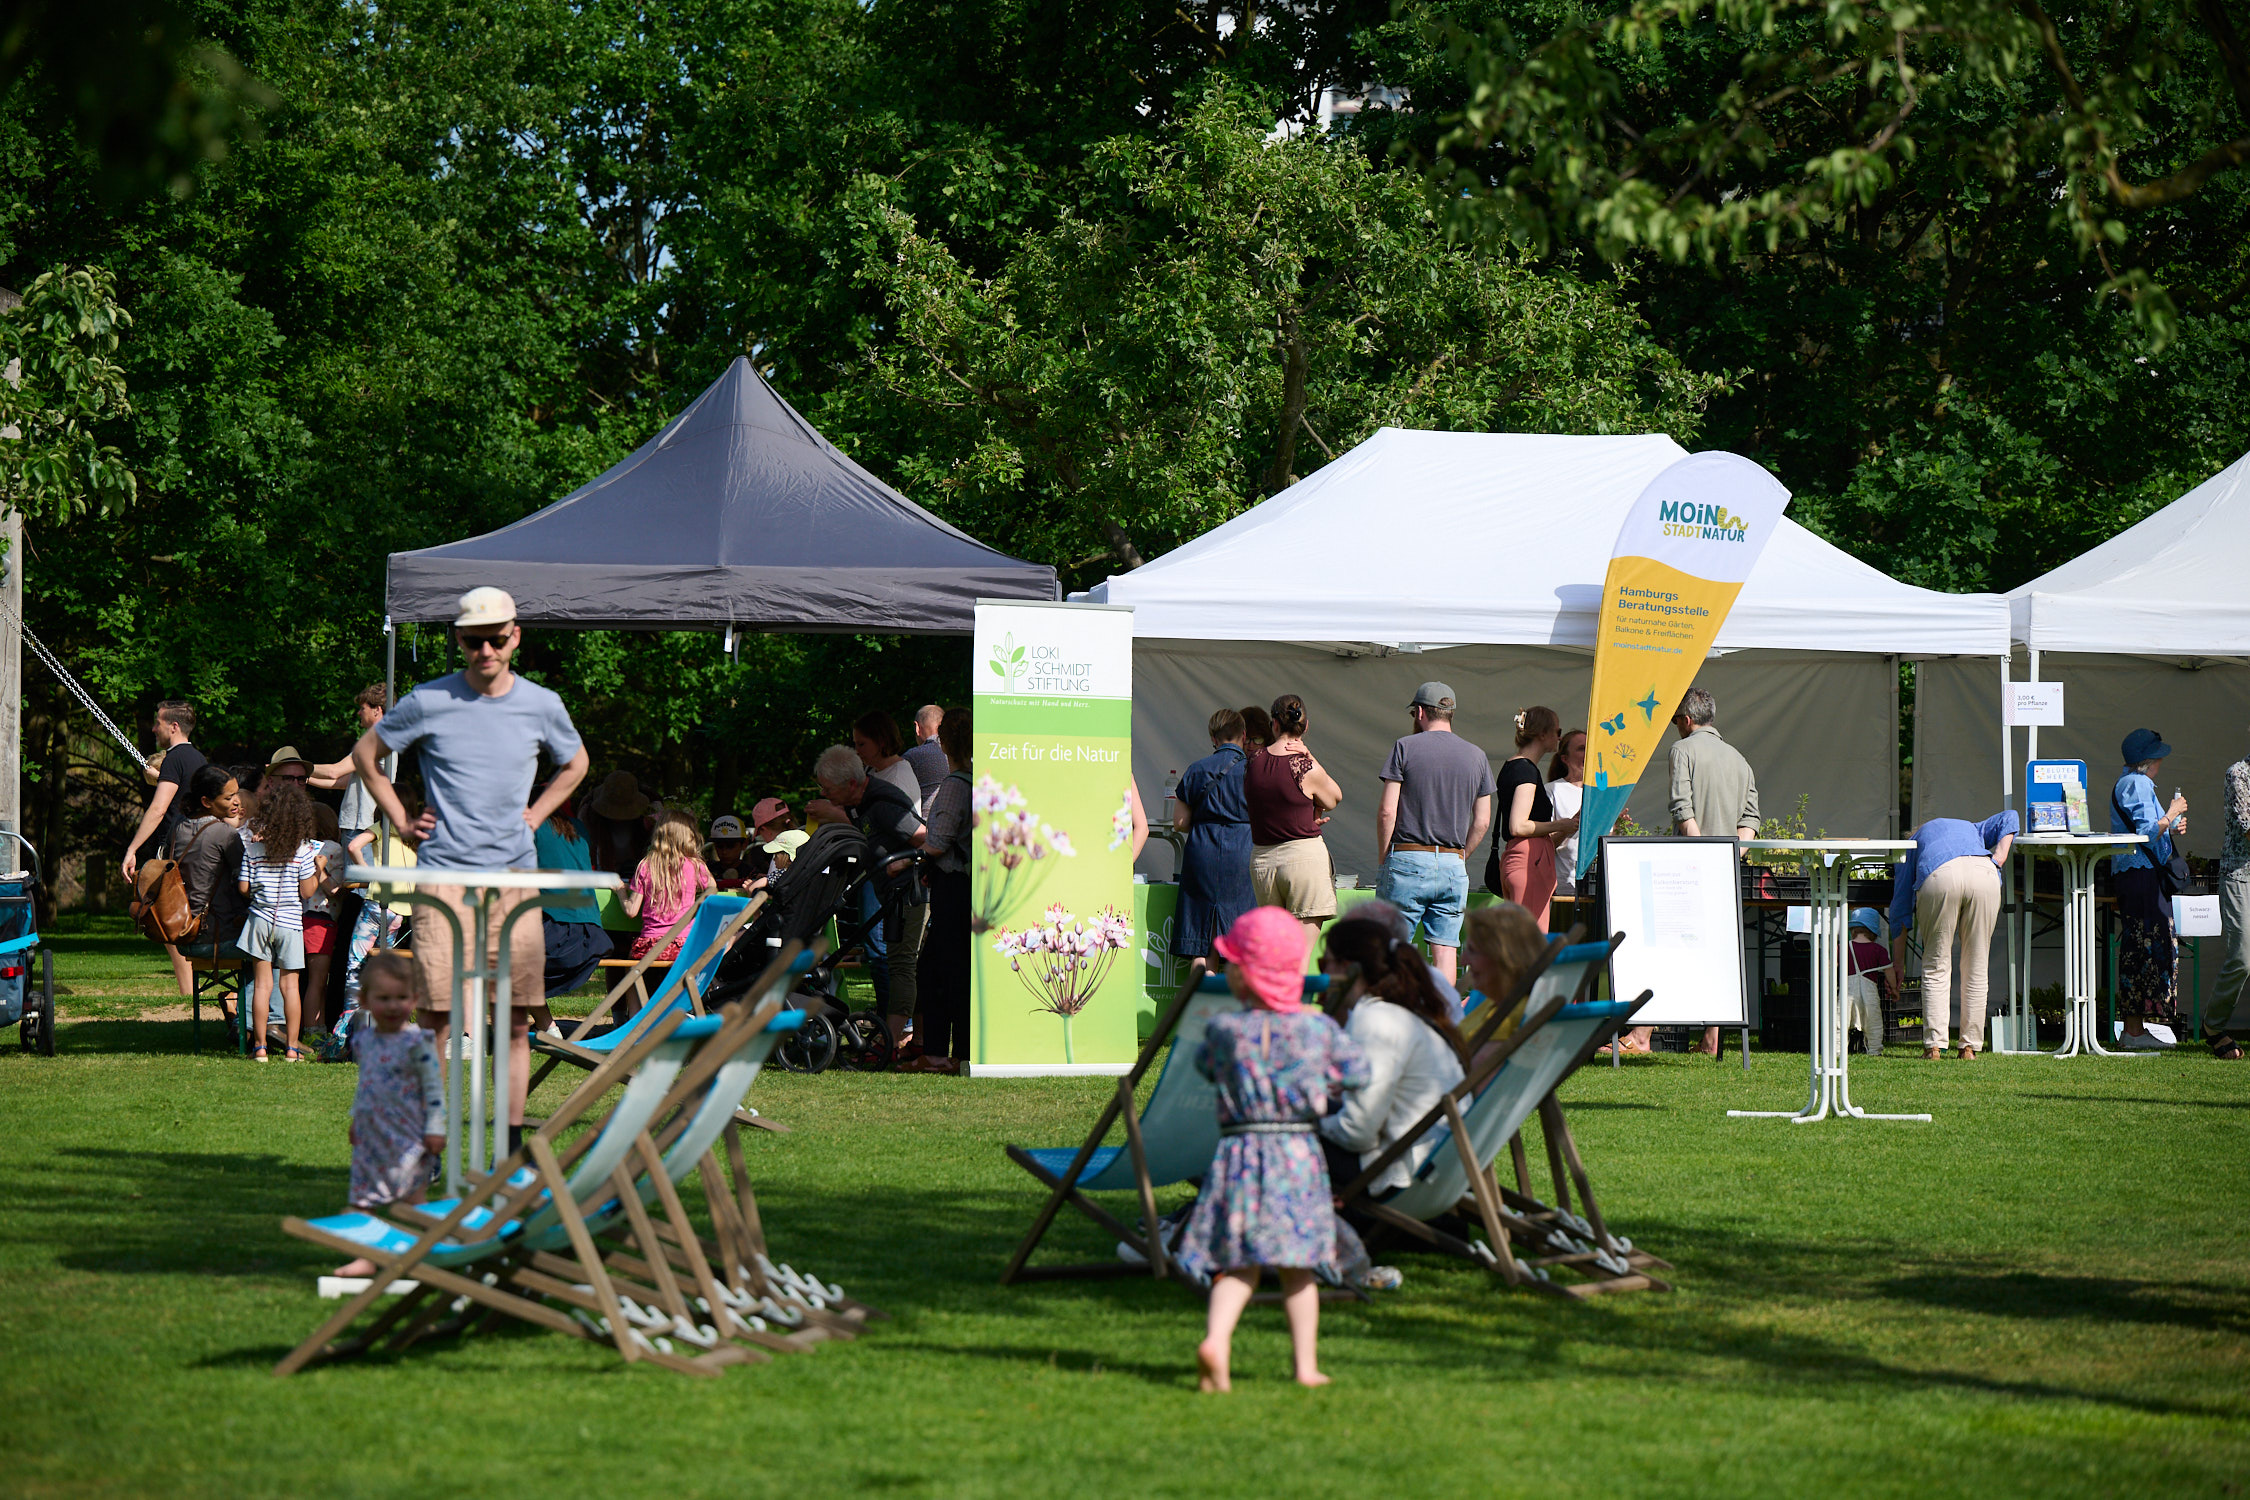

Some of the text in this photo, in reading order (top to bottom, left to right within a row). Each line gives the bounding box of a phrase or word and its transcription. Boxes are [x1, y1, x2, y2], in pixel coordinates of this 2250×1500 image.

[1663, 523, 1745, 542] STADTNATUR
[1619, 586, 1679, 602] Hamburgs
[1618, 599, 1709, 617] Beratungsstelle
[1616, 615, 1695, 630] für naturnahe Gärten,
[1615, 625, 1694, 640] Balkone & Freiflächen
[1031, 646, 1060, 659] LOKI
[1613, 641, 1683, 655] moinstadtnatur.de
[1034, 662, 1092, 676] SCHMIDT
[1028, 677, 1090, 692] STIFTUNG
[990, 698, 1027, 706] Naturschutz
[1042, 699, 1059, 707] Hand
[1073, 700, 1091, 708] Herz.
[989, 742, 1120, 762] Zeit für die Natur
